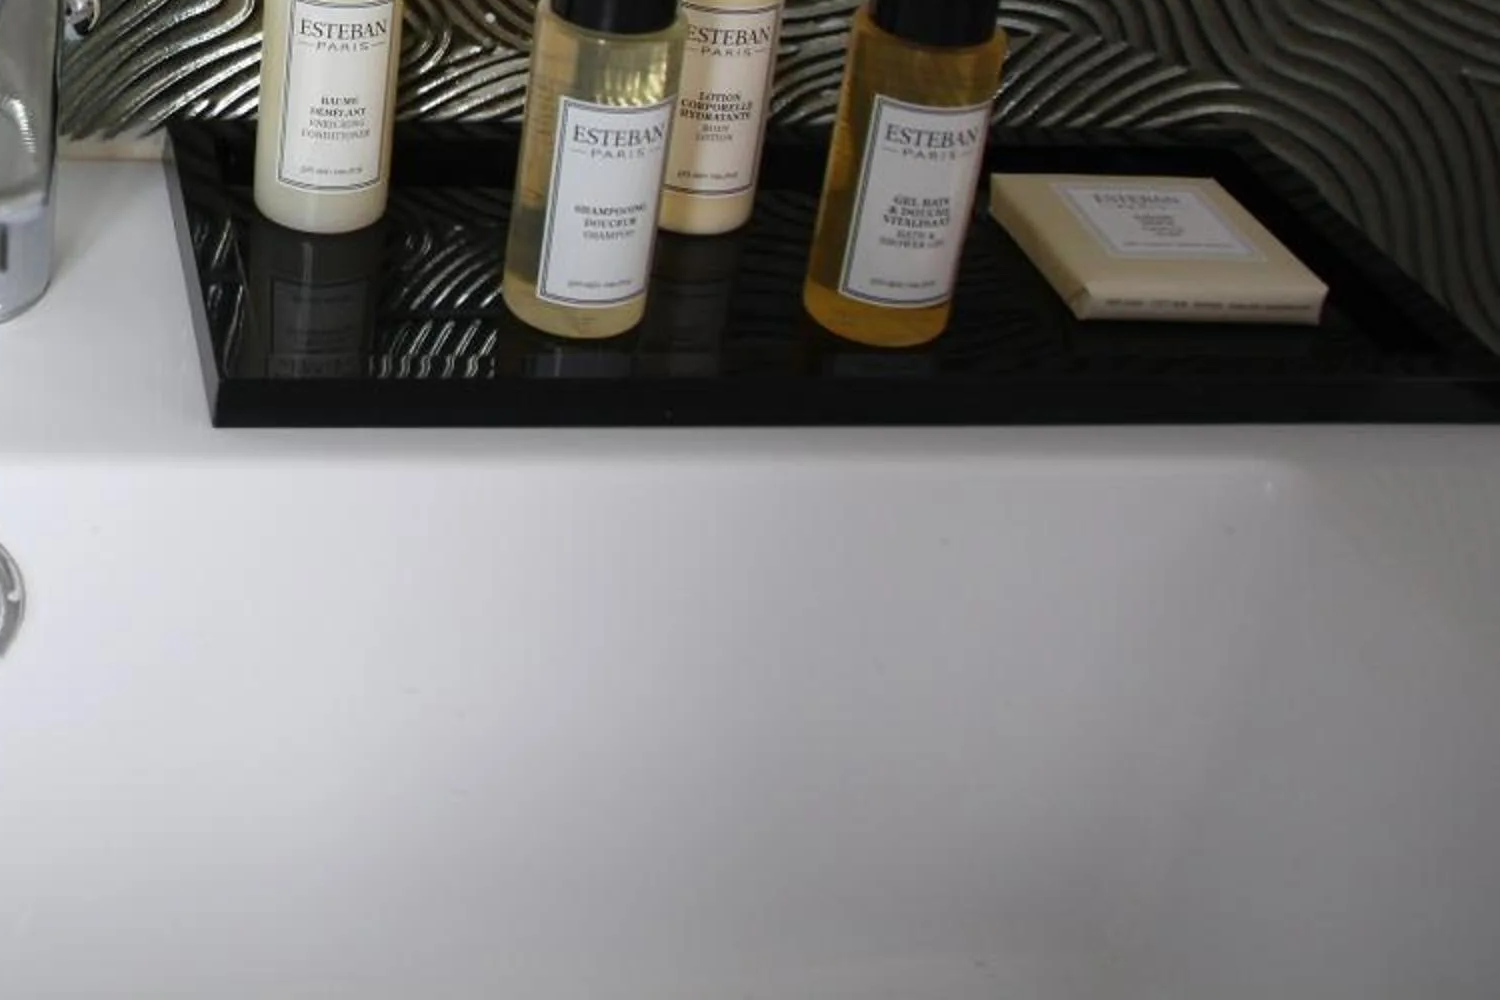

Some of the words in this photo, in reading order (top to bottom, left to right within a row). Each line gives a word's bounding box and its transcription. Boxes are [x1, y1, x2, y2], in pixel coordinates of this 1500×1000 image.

[299, 18, 387, 40] ESTEBAN
[688, 24, 771, 45] ESTEBAN
[316, 41, 369, 51] PARIS
[701, 47, 751, 56] PARIS
[573, 123, 665, 147] ESTEBAN
[884, 123, 980, 149] ESTEBAN
[591, 150, 645, 159] PARIS
[902, 149, 957, 160] PARIS
